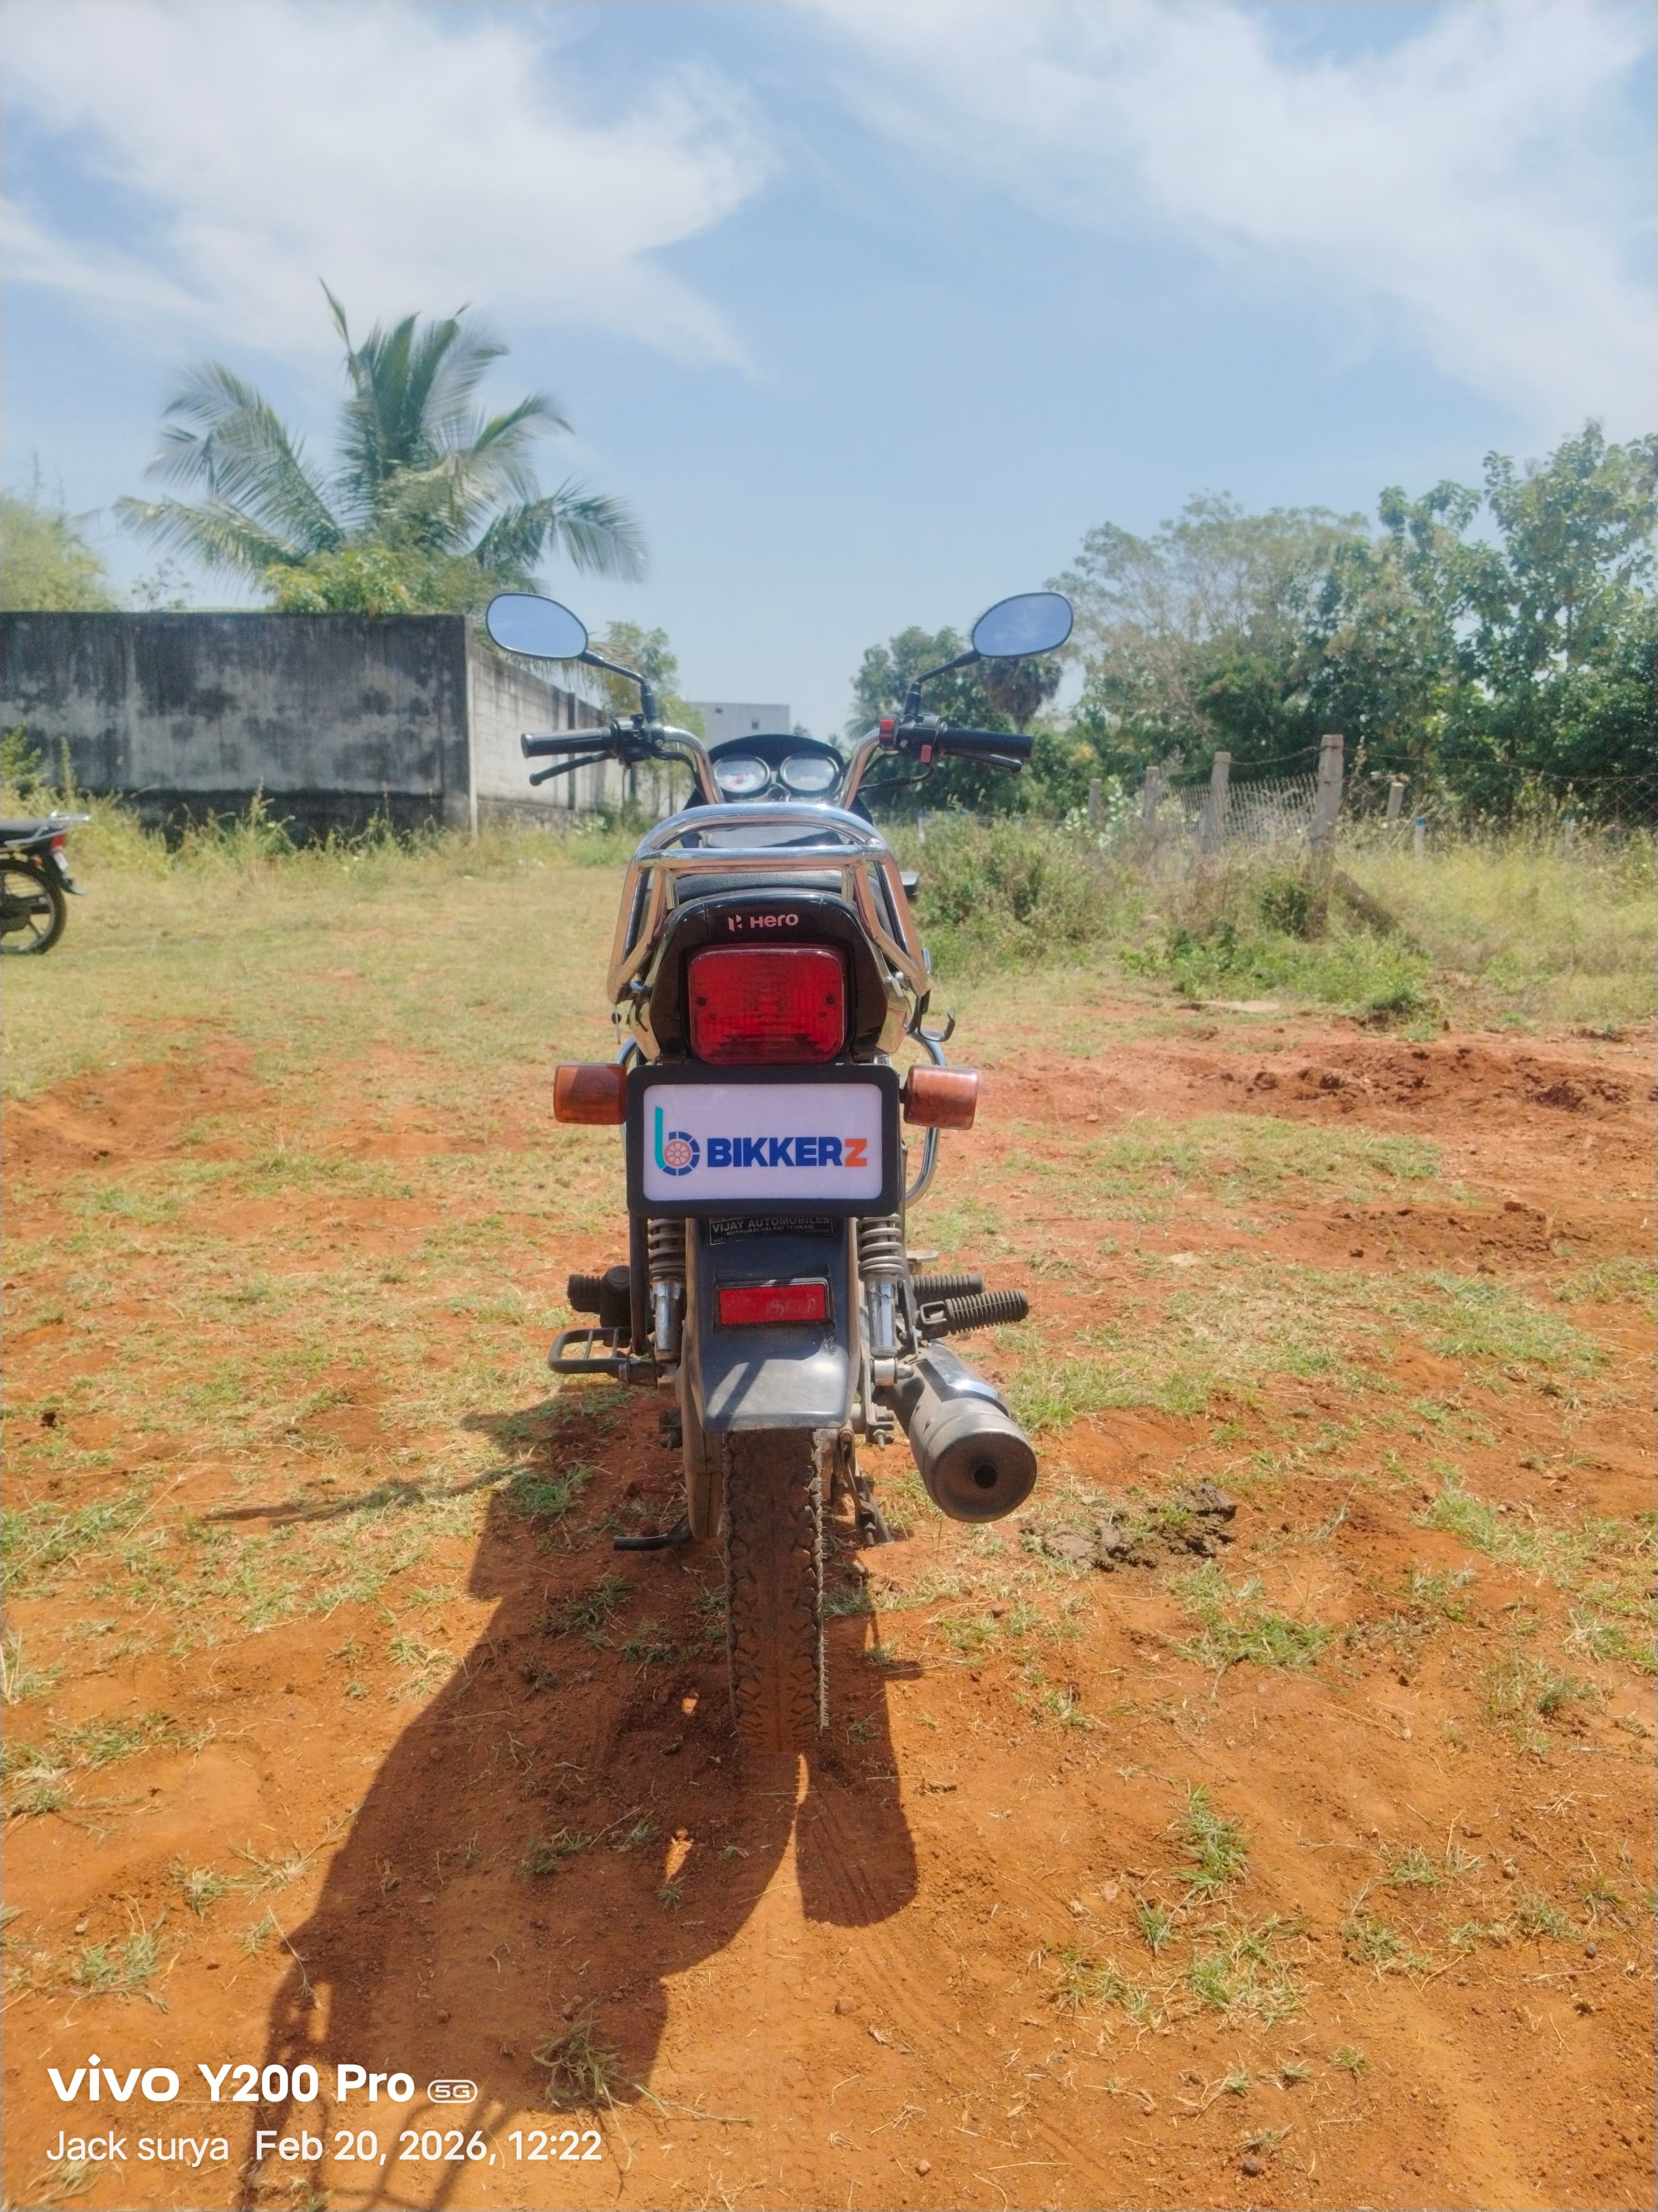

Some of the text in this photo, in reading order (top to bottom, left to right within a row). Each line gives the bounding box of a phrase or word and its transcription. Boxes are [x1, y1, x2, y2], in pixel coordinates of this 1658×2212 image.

[750, 914, 798, 928] Hero
[707, 1136, 868, 1168] BIKKERZ
[713, 1216, 829, 1233] VIJAY AUTOMOBILES
